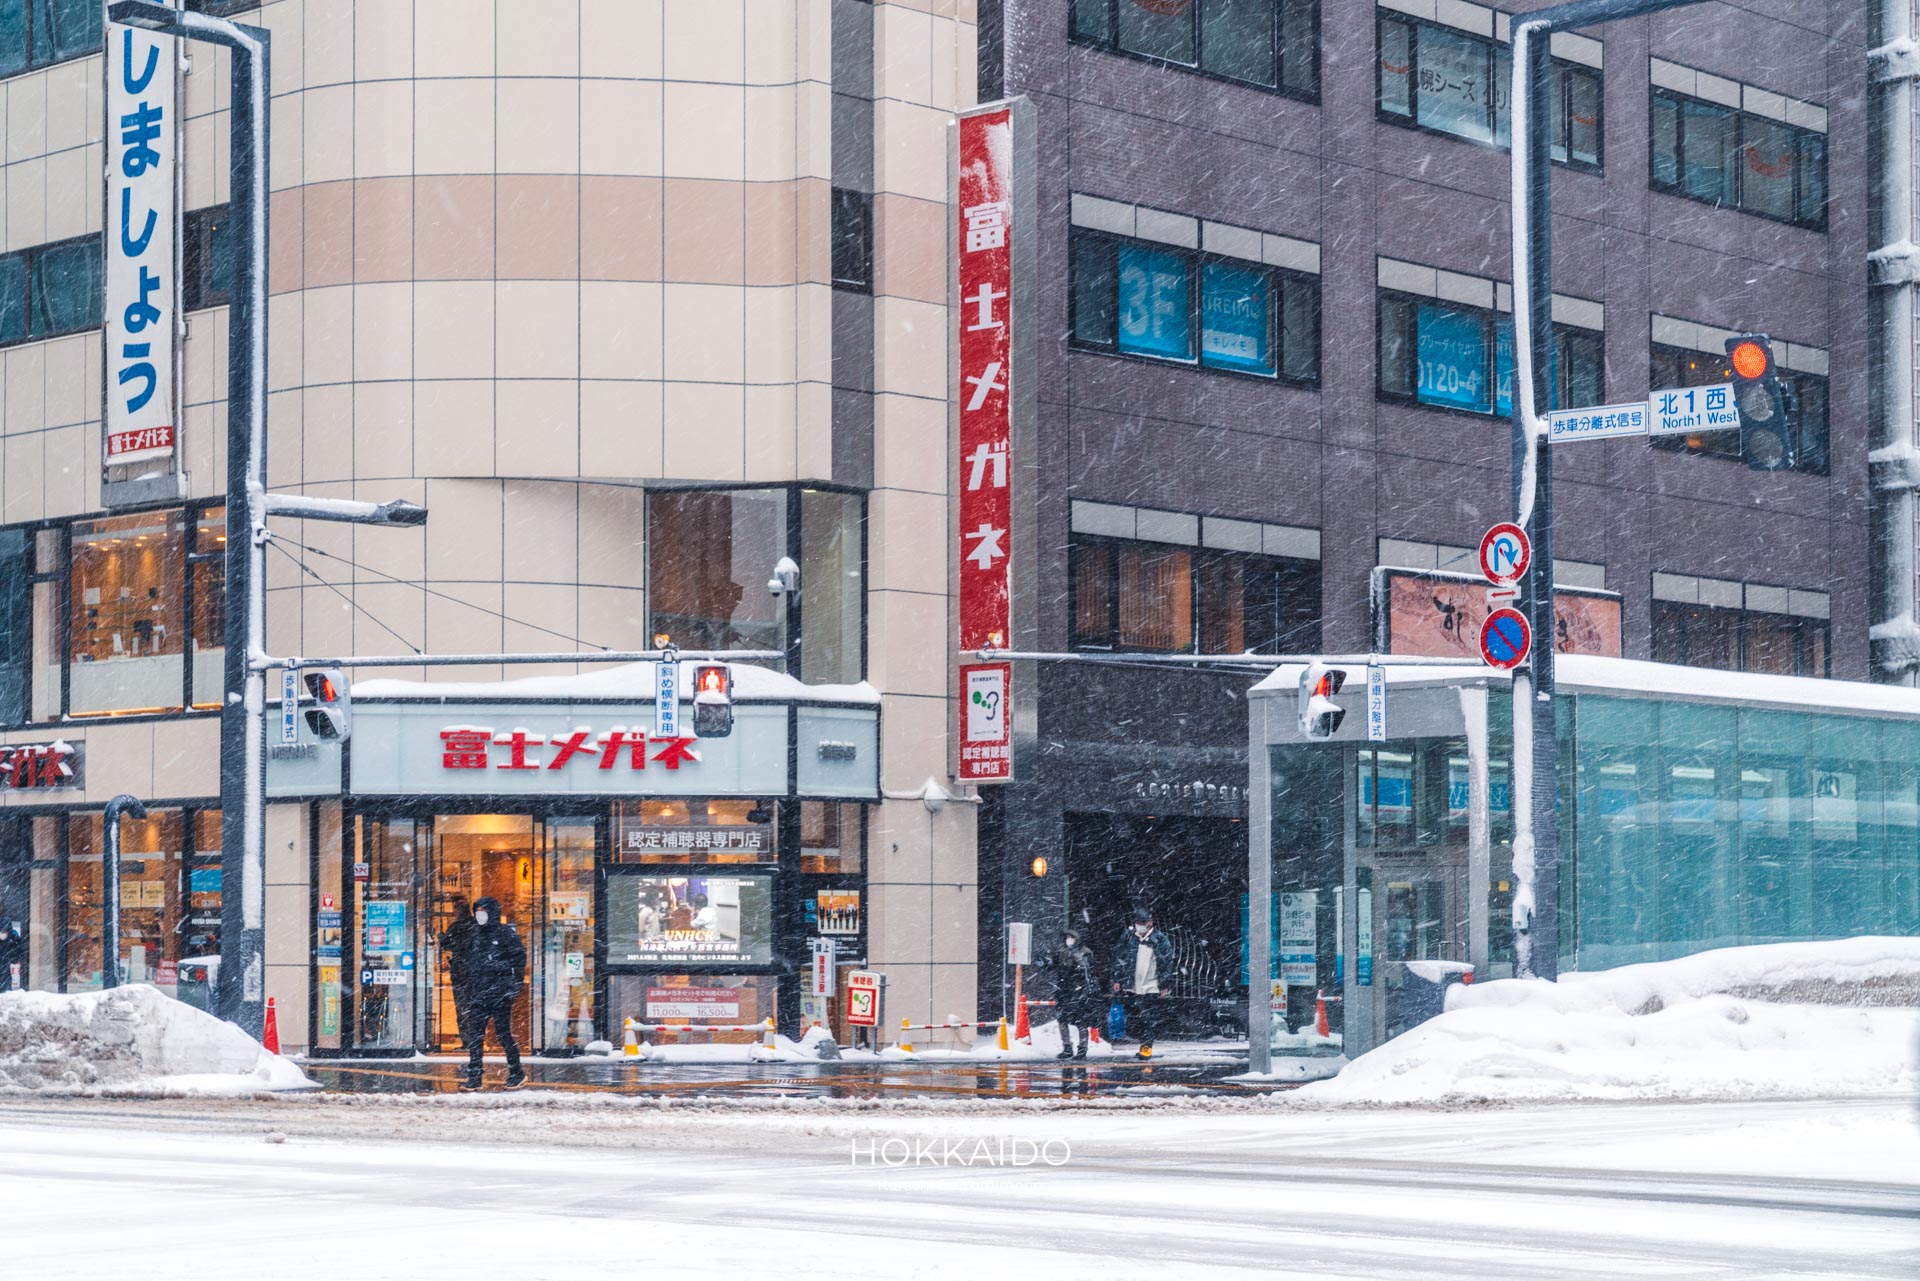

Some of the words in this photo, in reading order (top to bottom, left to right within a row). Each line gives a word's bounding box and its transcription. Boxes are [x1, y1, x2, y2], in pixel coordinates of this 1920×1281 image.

[118, 28, 163, 415] しましょう
[1122, 266, 1176, 338] 3F
[964, 203, 1007, 570] 富士メガネ
[1553, 411, 1643, 434] 歩車分離式信号
[1708, 410, 1737, 424] West
[111, 428, 170, 453] 富士メガネ
[285, 675, 294, 738] 歩車分離式
[661, 667, 674, 733] 斜め横断専用
[1372, 672, 1382, 737] 歩車分離式
[440, 729, 700, 770] 富士メガネ
[972, 761, 999, 774] 専門店
[628, 831, 761, 848] 認定補聴器専門店
[664, 929, 714, 942] UNHCR
[1282, 929, 1315, 937] クリニック
[362, 971, 372, 983] P
